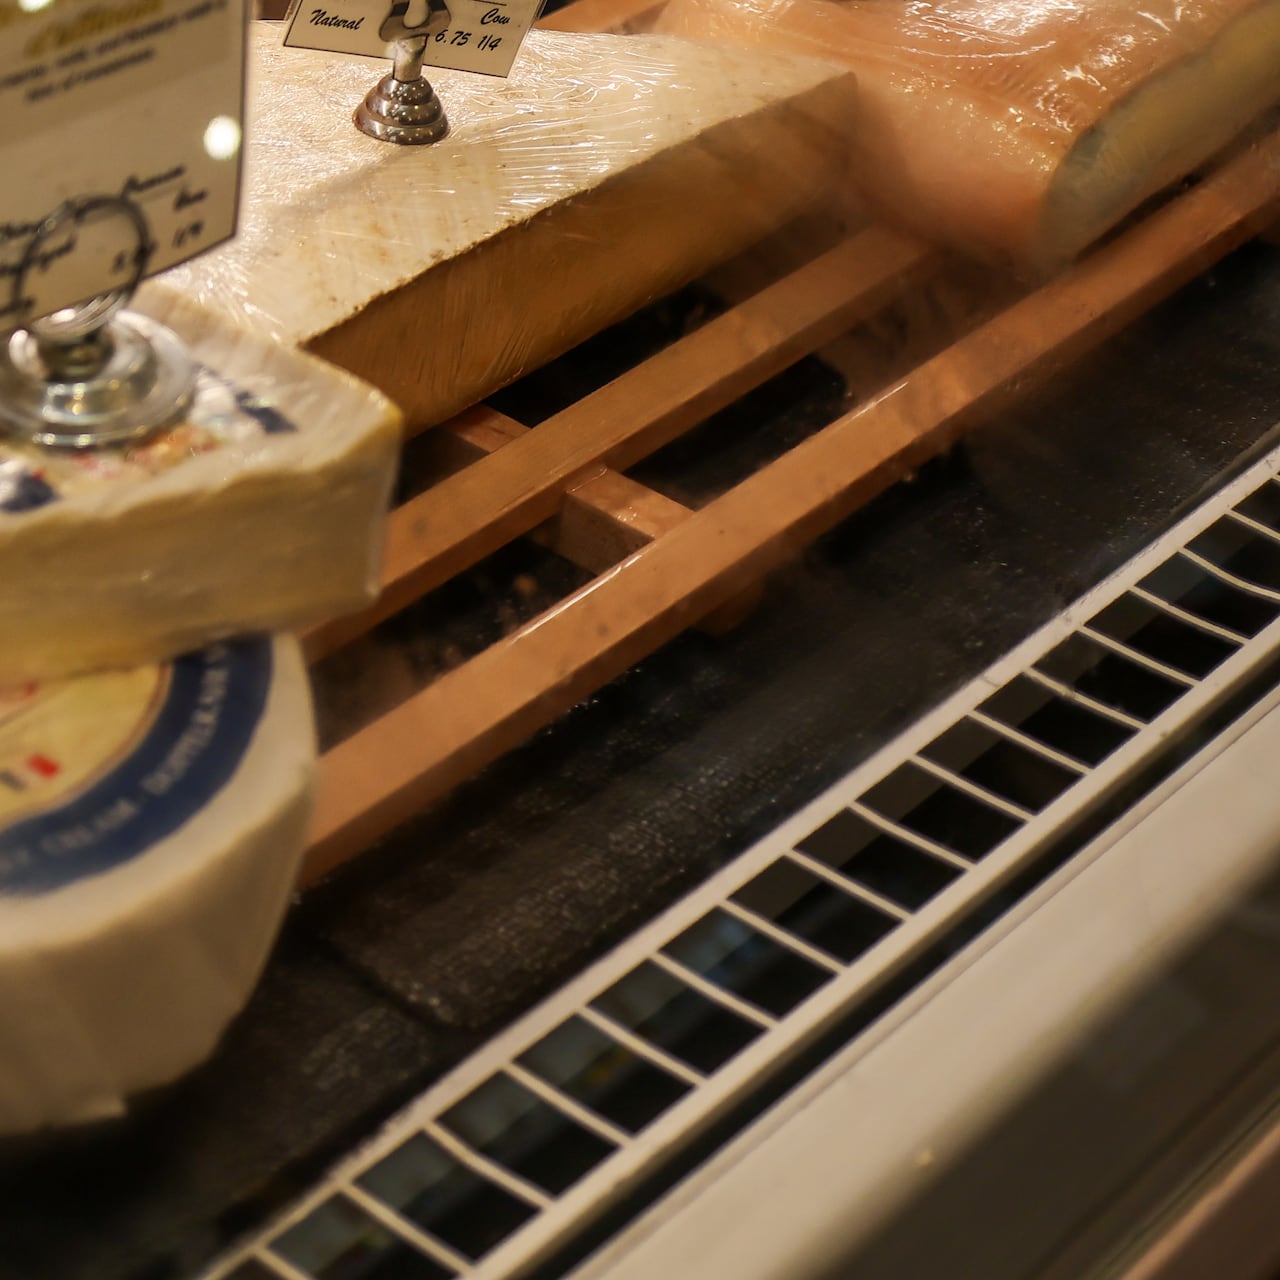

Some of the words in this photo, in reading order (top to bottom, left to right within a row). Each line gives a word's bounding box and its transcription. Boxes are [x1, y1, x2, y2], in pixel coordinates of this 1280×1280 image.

[309, 8, 365, 30] Natural
[480, 7, 510, 25] Cow
[435, 28, 472, 46] 6.75
[477, 34, 502, 51] 1/4
